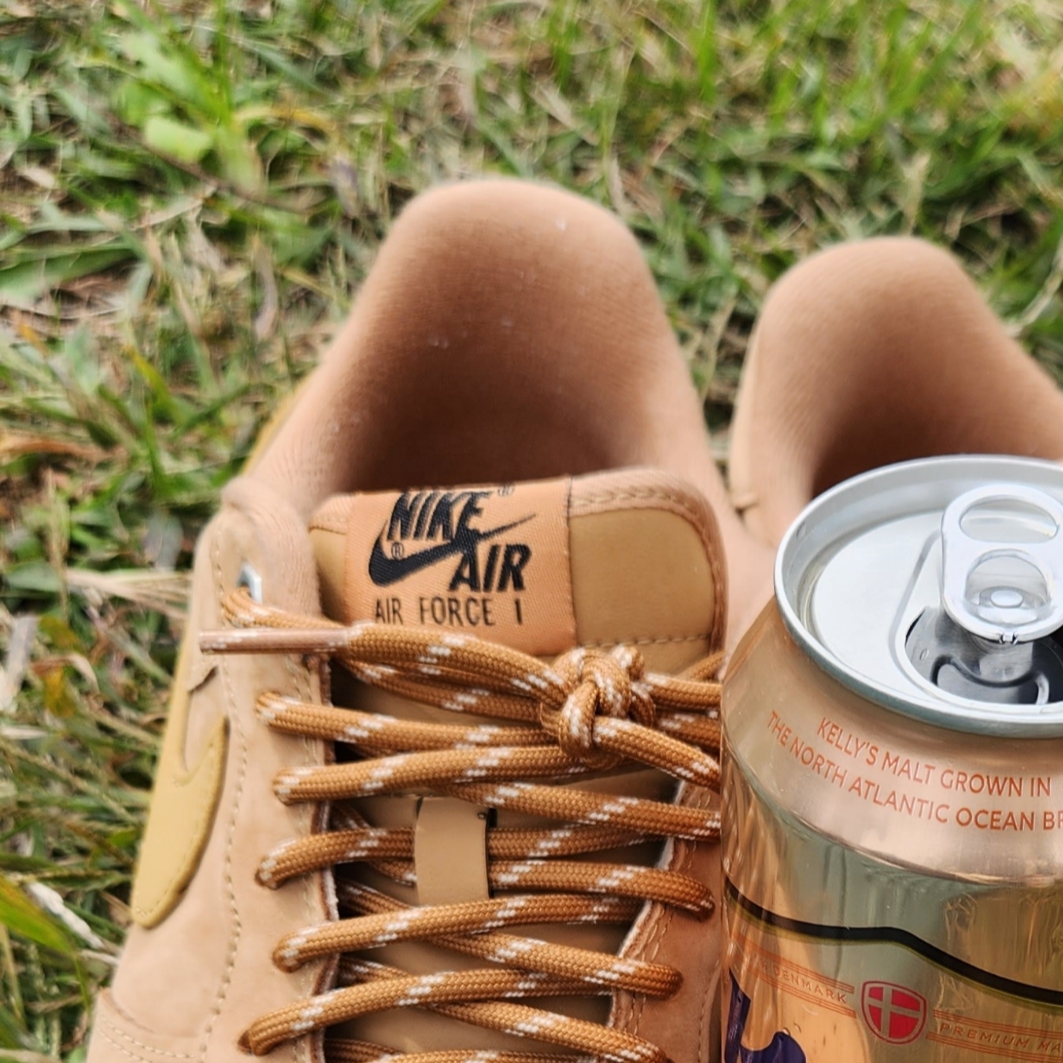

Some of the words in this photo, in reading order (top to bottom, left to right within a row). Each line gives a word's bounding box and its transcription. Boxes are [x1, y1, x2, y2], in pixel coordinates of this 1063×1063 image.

[386, 490, 493, 541] NIKE
[449, 542, 532, 593] AIR
[375, 597, 404, 625] AIR
[419, 596, 494, 626] FORCE
[766, 709, 789, 748] THE
[789, 739, 848, 788] NORTH
[848, 775, 950, 823] ATLANTIC
[955, 806, 1036, 832] OCEAN
[817, 716, 880, 767] KELLY'S
[881, 750, 933, 786] MALT
[940, 768, 1023, 799] GROWN
[1030, 776, 1052, 798] IN
[940, 1022, 1031, 1052] PREMIUM
